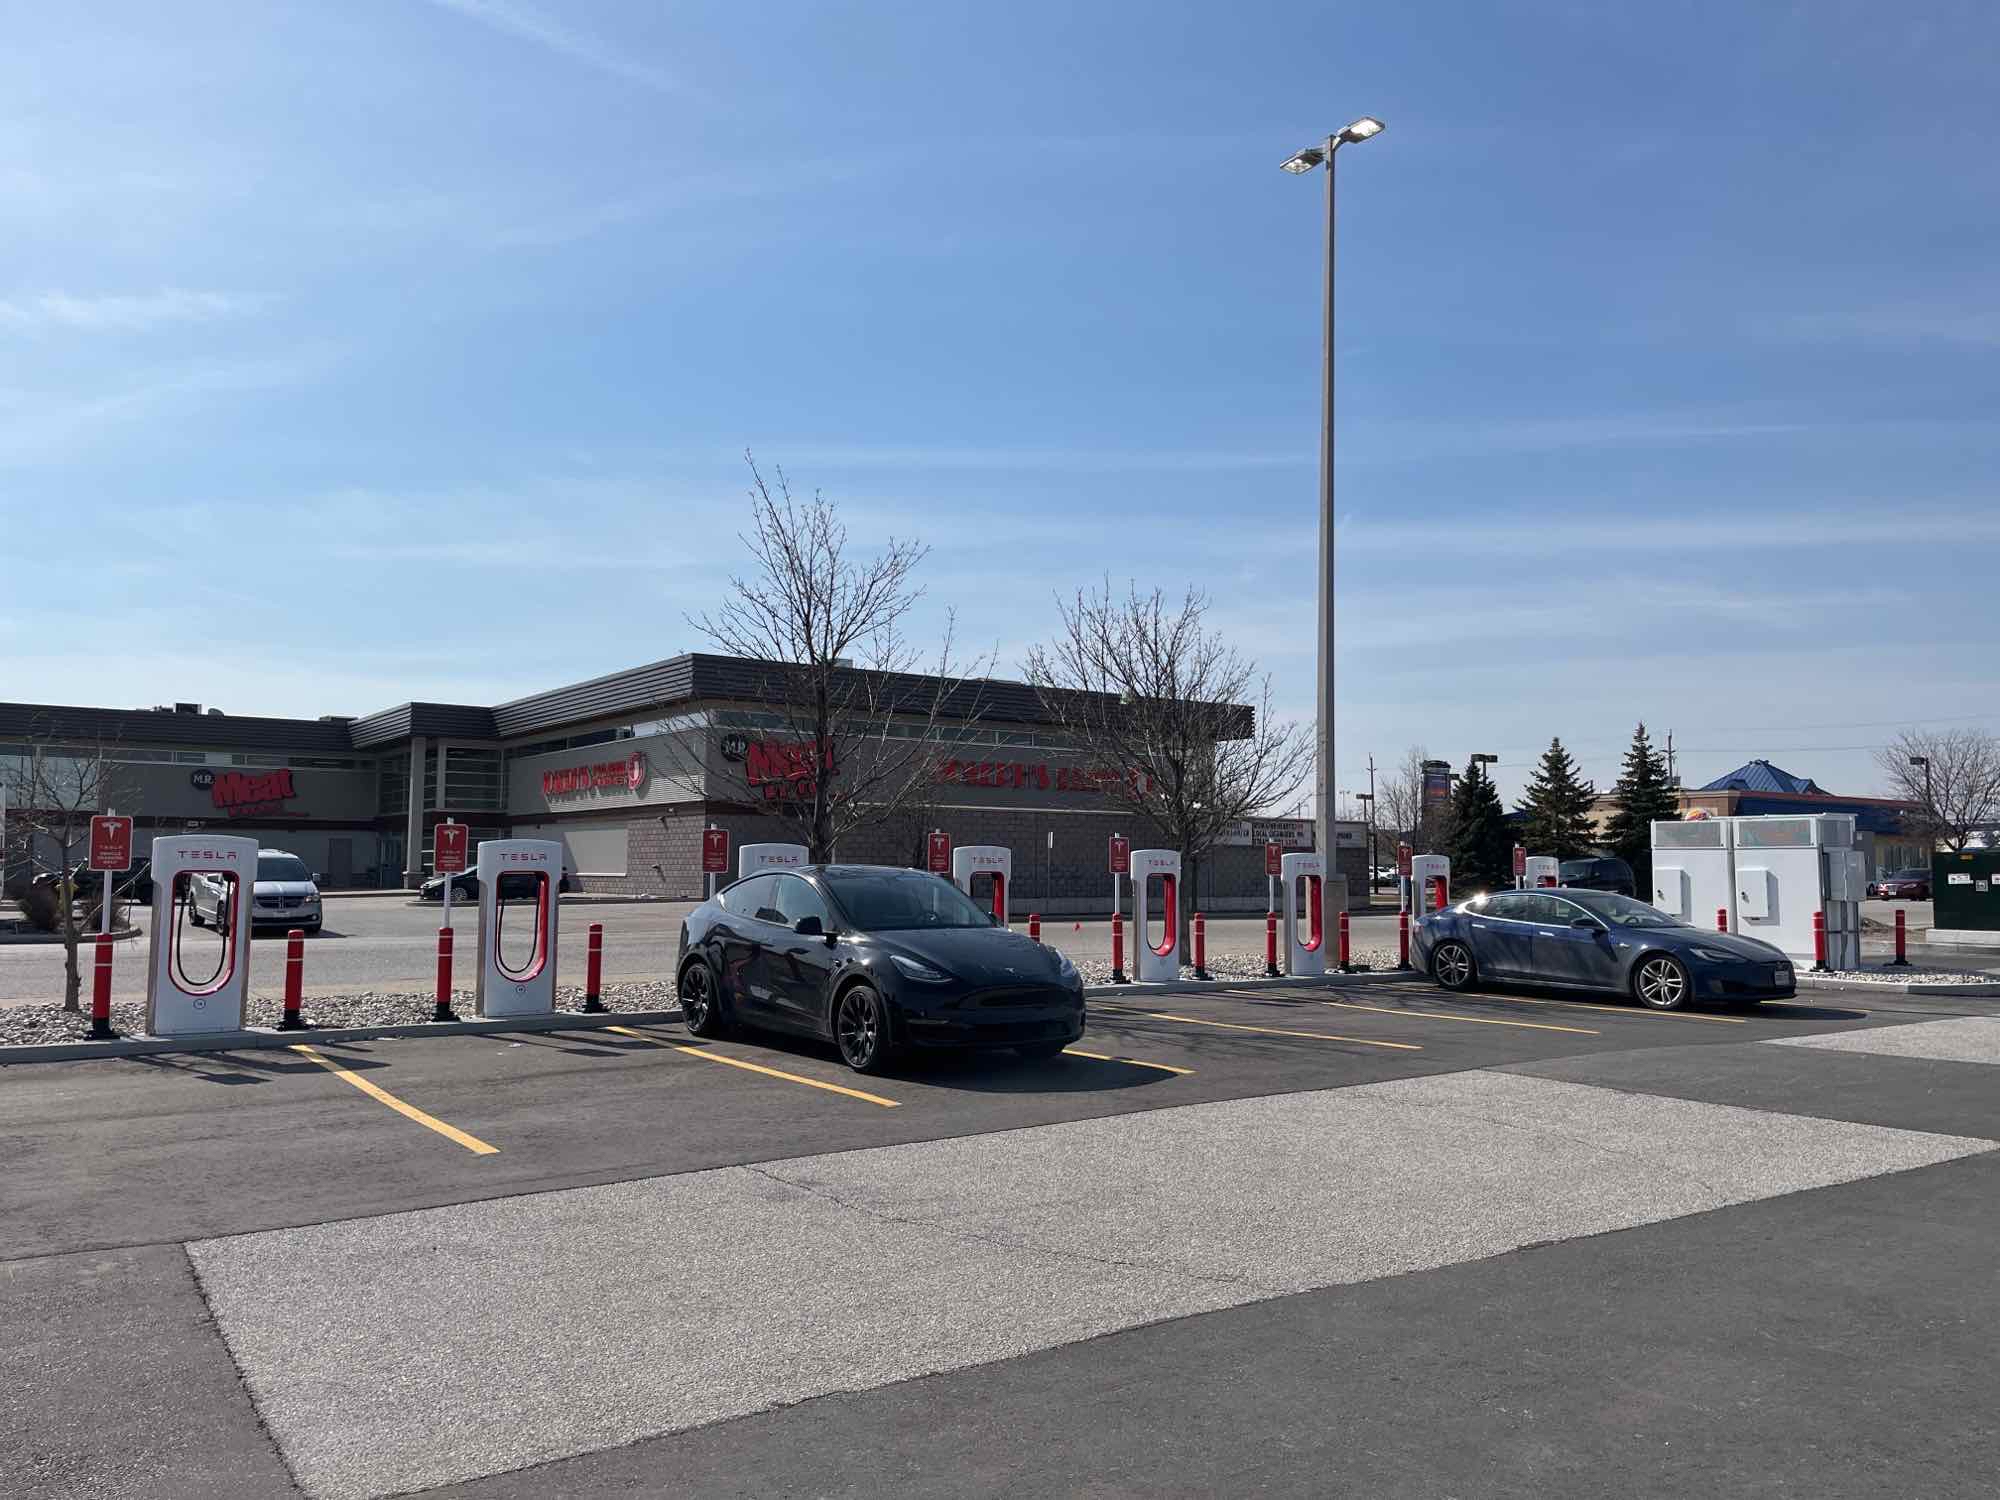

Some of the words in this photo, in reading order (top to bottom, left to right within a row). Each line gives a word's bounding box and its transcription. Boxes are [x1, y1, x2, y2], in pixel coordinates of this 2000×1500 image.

[177, 850, 237, 860] TESLA
[499, 853, 547, 861] TESLA
[760, 855, 798, 863] TESLA
[972, 856, 1004, 864] TESLA
